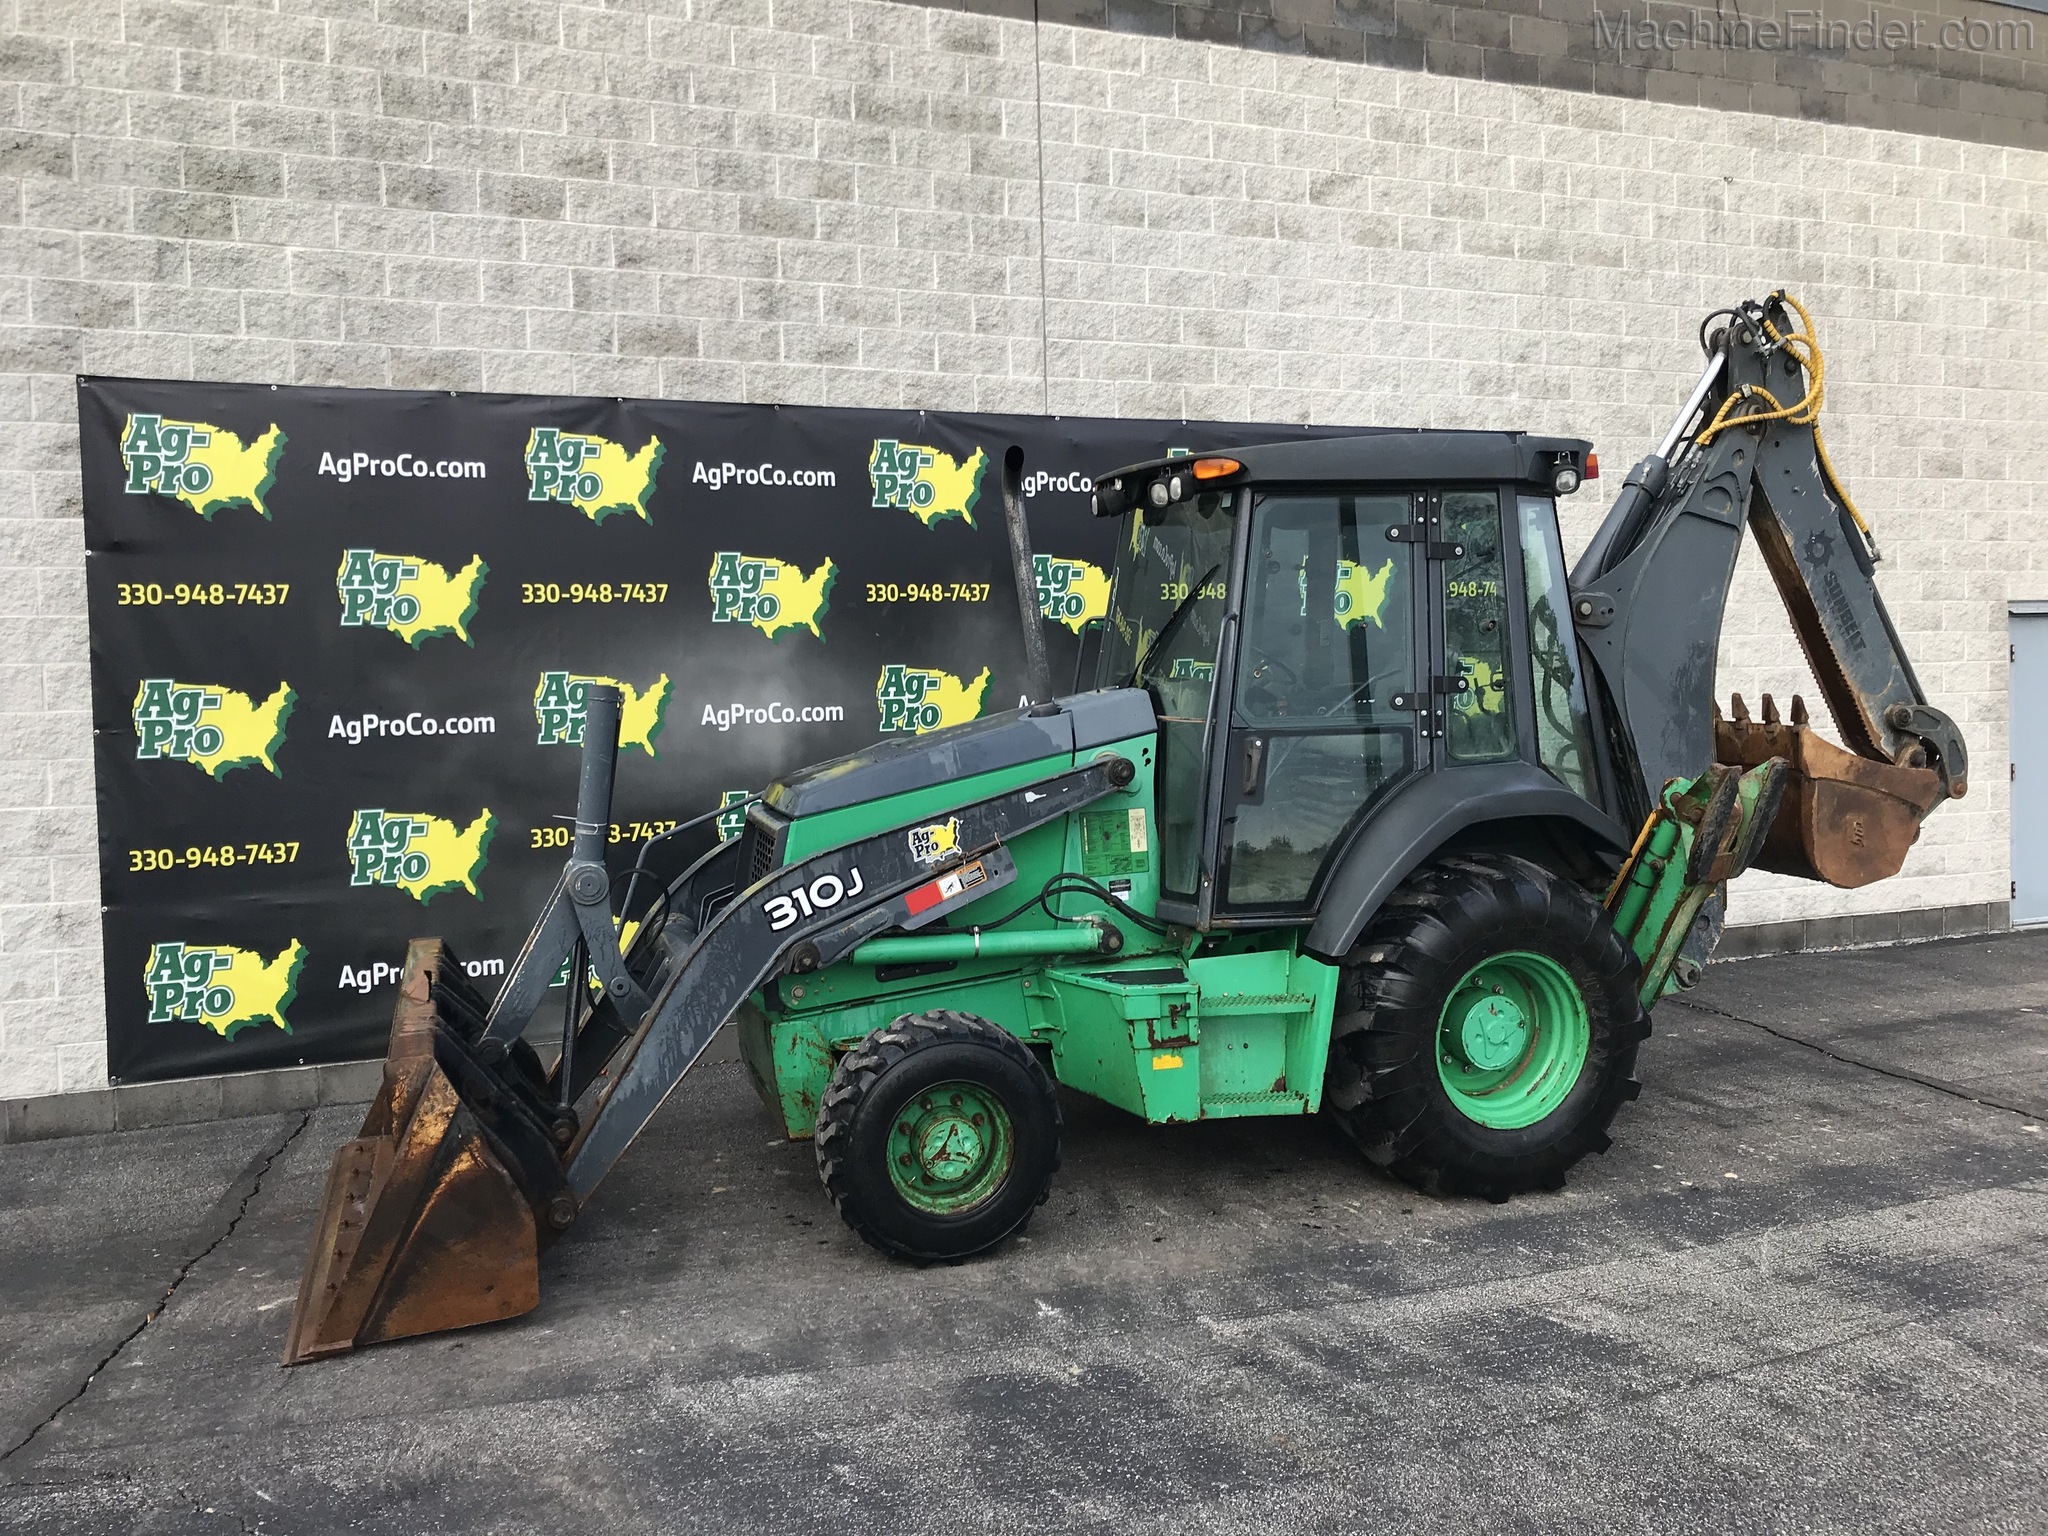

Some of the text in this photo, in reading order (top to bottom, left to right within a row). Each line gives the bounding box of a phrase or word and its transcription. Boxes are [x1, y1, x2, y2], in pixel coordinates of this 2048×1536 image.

[125, 414, 211, 462] Ag-
[528, 428, 601, 470] Ag-
[124, 453, 212, 494] Pro
[318, 451, 487, 482] AgProCo.com
[692, 462, 836, 490] AgProCo.com
[871, 439, 933, 479] Ag-
[528, 464, 602, 501] Pro
[872, 474, 934, 508] Pro
[341, 550, 419, 594] Ag-
[712, 552, 778, 592] Ag-
[117, 583, 290, 606] 330-948-7437
[340, 587, 420, 626] Pro
[522, 583, 668, 604] 330-948-7437
[712, 587, 780, 622] Pro
[866, 583, 991, 603] 330-948-7437
[1824, 571, 1866, 651] SUNBELT
[879, 665, 940, 702] Ag-
[136, 679, 222, 726] Ag-
[701, 702, 844, 732] AgProCo.com
[880, 699, 941, 732] Pro
[137, 718, 223, 760] Pro
[328, 712, 496, 745] AgProCo.com
[350, 809, 428, 854] Ag-
[531, 821, 677, 849] 330-8-7437
[912, 830, 934, 846] Ag-
[914, 842, 938, 858] Pro
[129, 842, 300, 872] 330-948-7437
[350, 847, 430, 887] Pro
[764, 867, 864, 932] 310J
[148, 942, 232, 983] Ag-
[148, 981, 236, 1024] Pro
